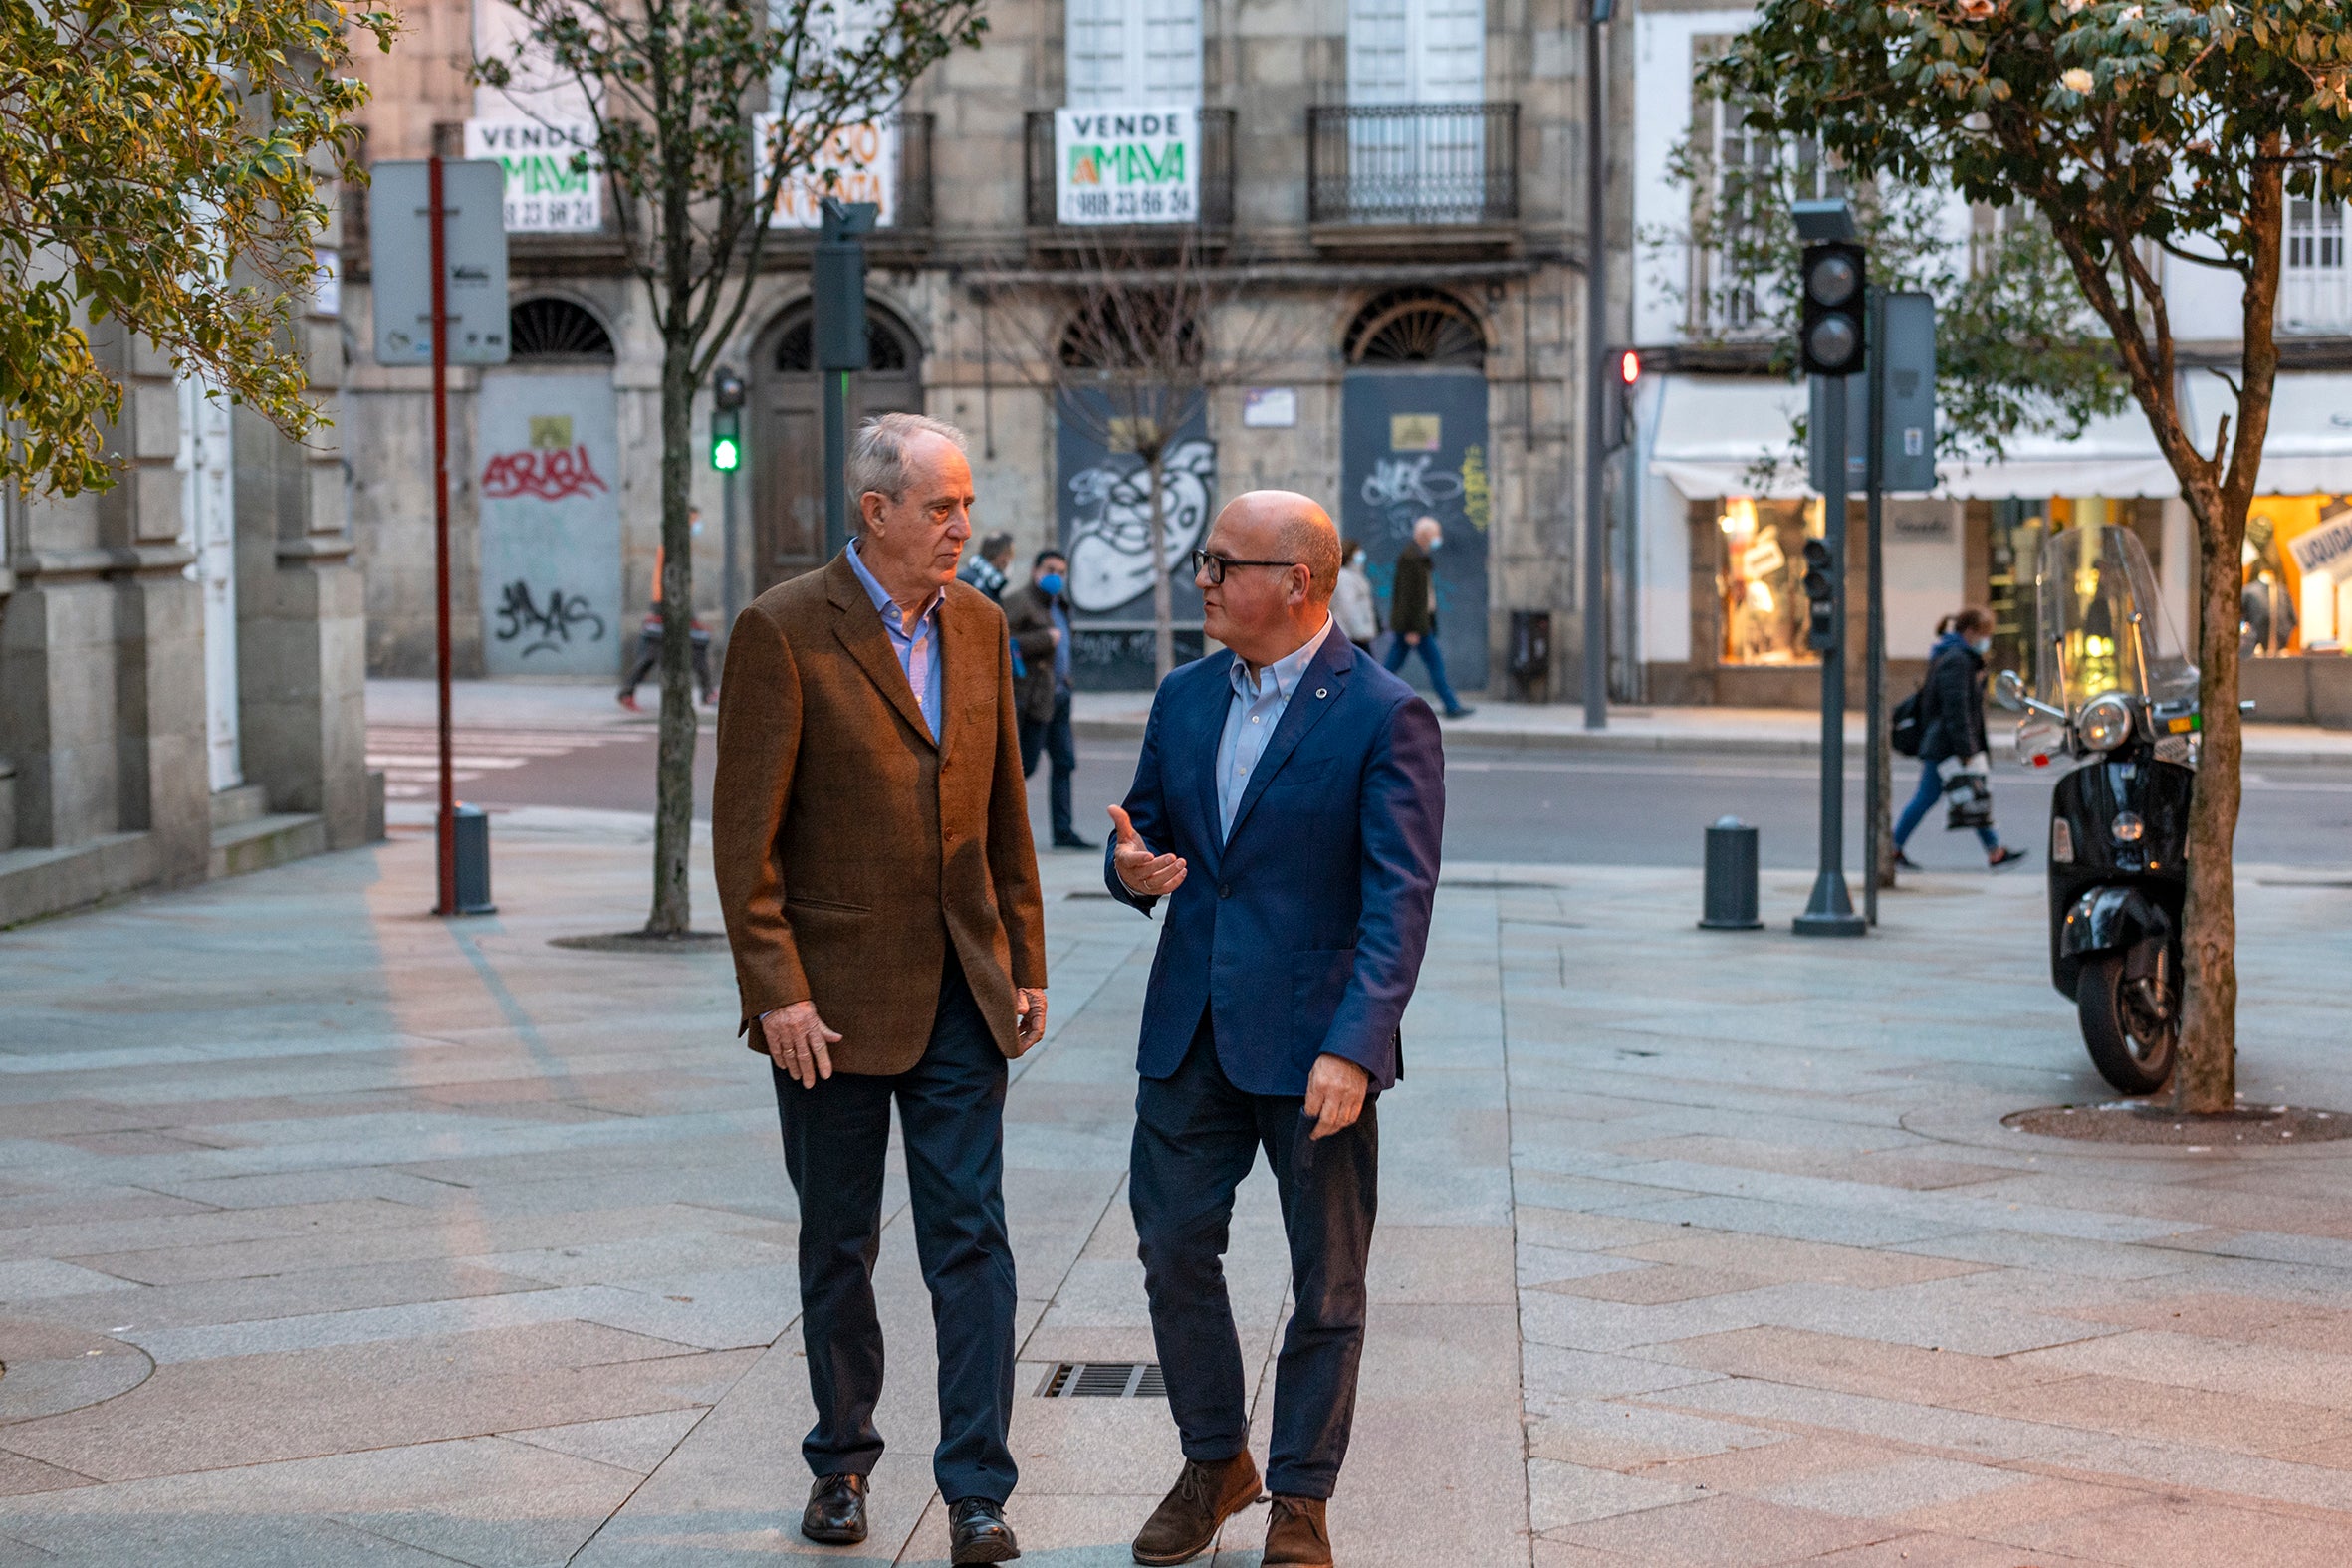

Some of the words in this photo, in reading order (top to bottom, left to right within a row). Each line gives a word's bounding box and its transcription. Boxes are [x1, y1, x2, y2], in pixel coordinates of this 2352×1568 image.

[481, 125, 581, 149] VENDE
[1073, 114, 1178, 138] VENDE
[497, 154, 589, 196] MAVA
